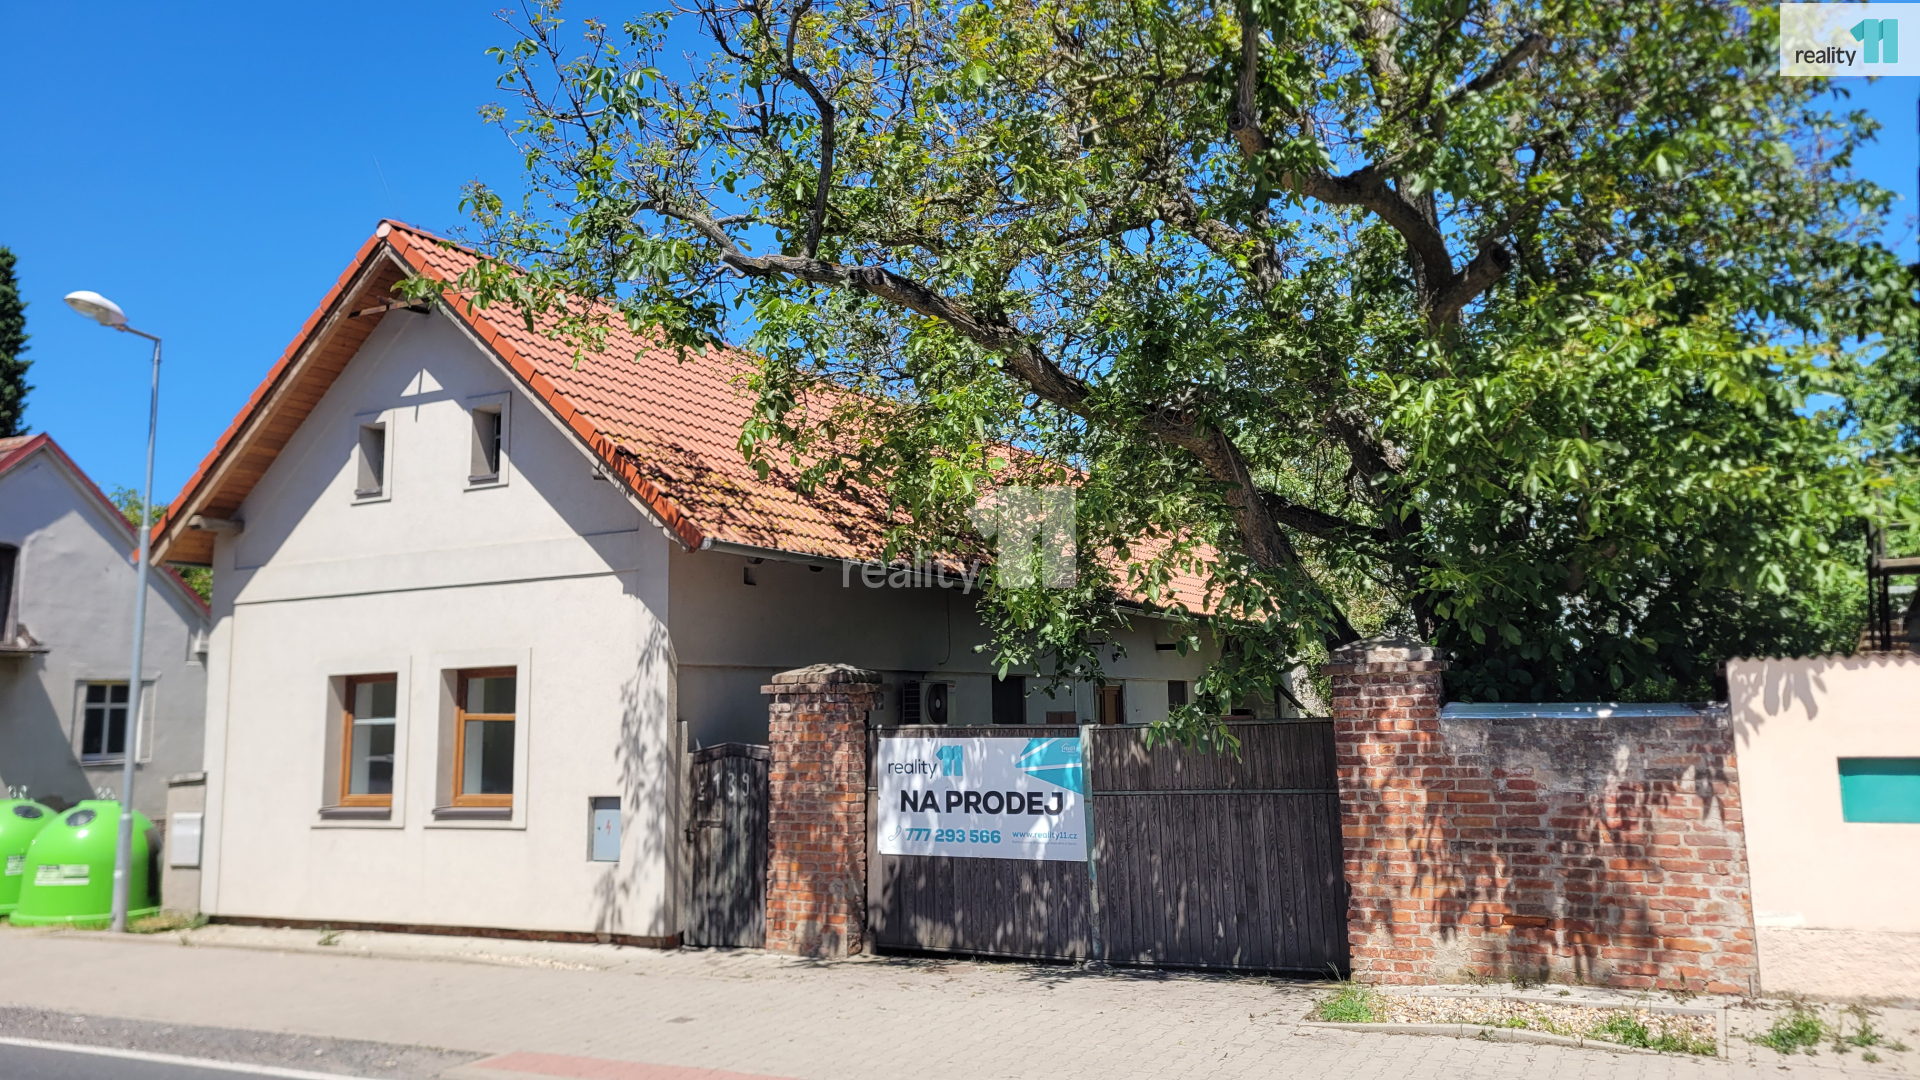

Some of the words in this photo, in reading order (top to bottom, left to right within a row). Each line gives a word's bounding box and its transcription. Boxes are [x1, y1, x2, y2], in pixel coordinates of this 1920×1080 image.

[888, 758, 938, 780] reality
[935, 745, 963, 777] 11
[713, 772, 750, 797] 139
[900, 789, 941, 813] NA
[945, 790, 1064, 816] PRODEJ
[905, 827, 932, 842] 777
[934, 828, 966, 843] 293
[969, 829, 1002, 845] 566
[1011, 830, 1078, 841] www.reality11.cz
